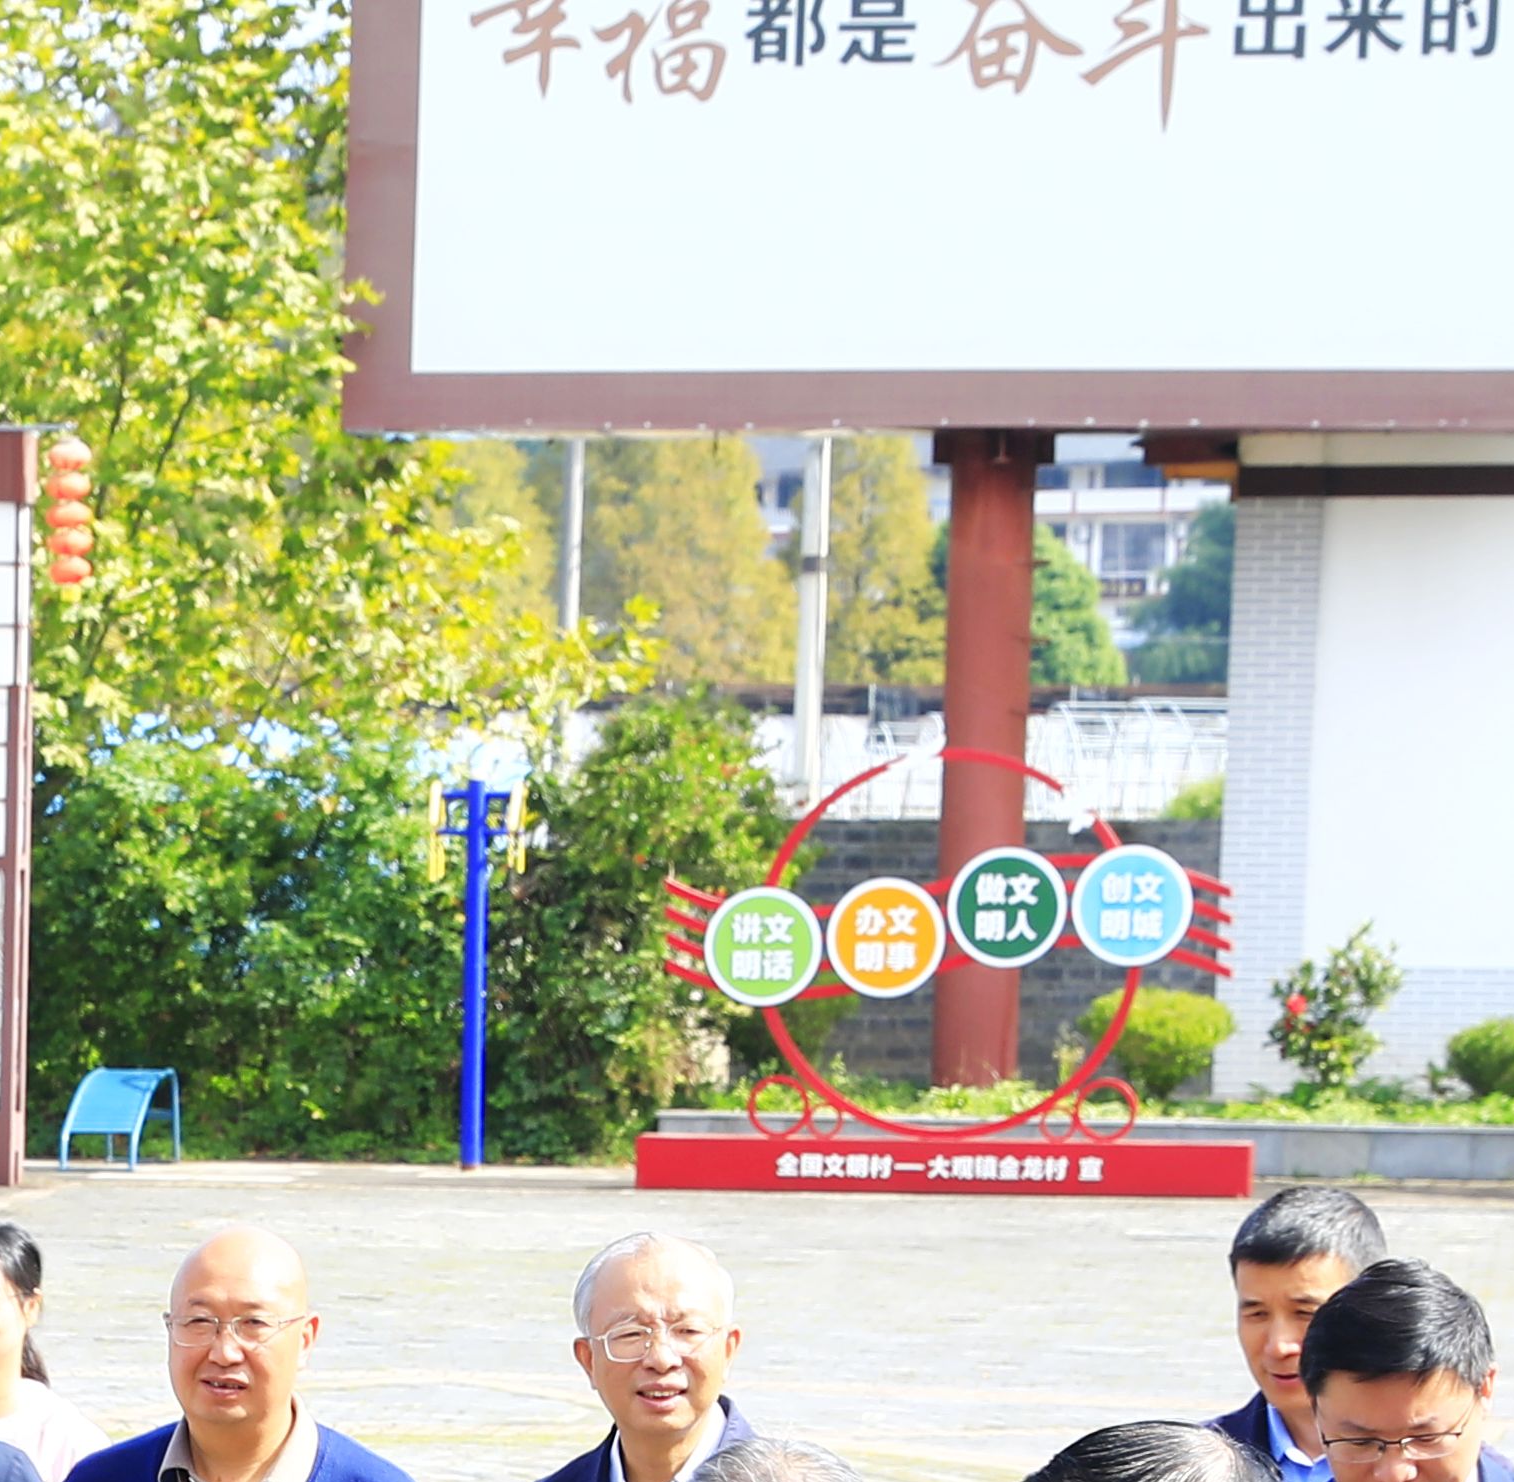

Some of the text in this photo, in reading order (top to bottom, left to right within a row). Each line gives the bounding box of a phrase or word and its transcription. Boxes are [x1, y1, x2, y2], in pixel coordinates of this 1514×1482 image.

[976, 872, 1040, 906] 做文
[1101, 872, 1166, 905] 创文
[732, 912, 794, 945] 讲文
[855, 904, 918, 936] 办文
[975, 910, 1037, 942] 明人
[1100, 909, 1163, 941] 明城
[731, 949, 793, 982] 明话
[854, 942, 917, 973] 明事
[1078, 1157, 1103, 1181] 宣
